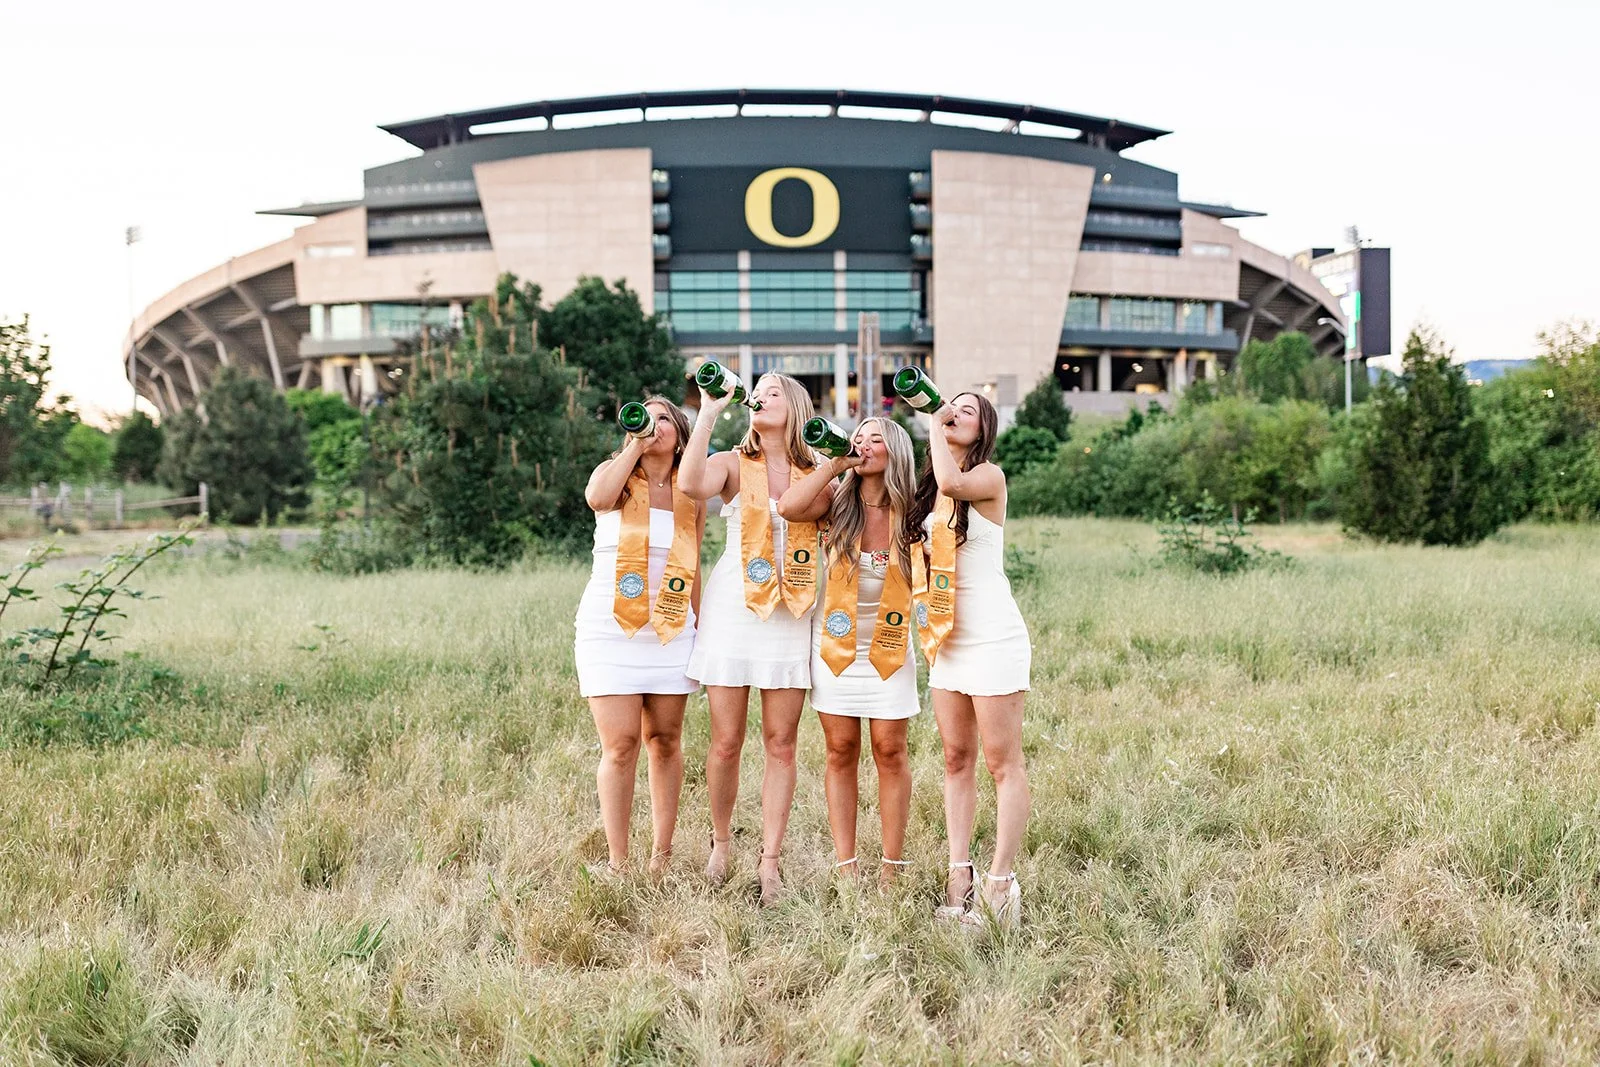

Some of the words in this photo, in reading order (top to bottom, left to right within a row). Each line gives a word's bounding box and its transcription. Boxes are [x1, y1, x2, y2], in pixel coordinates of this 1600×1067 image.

[744, 167, 840, 248] O
[793, 549, 810, 564] O
[669, 577, 685, 592] O
[935, 574, 949, 590] O
[885, 611, 903, 626] O
